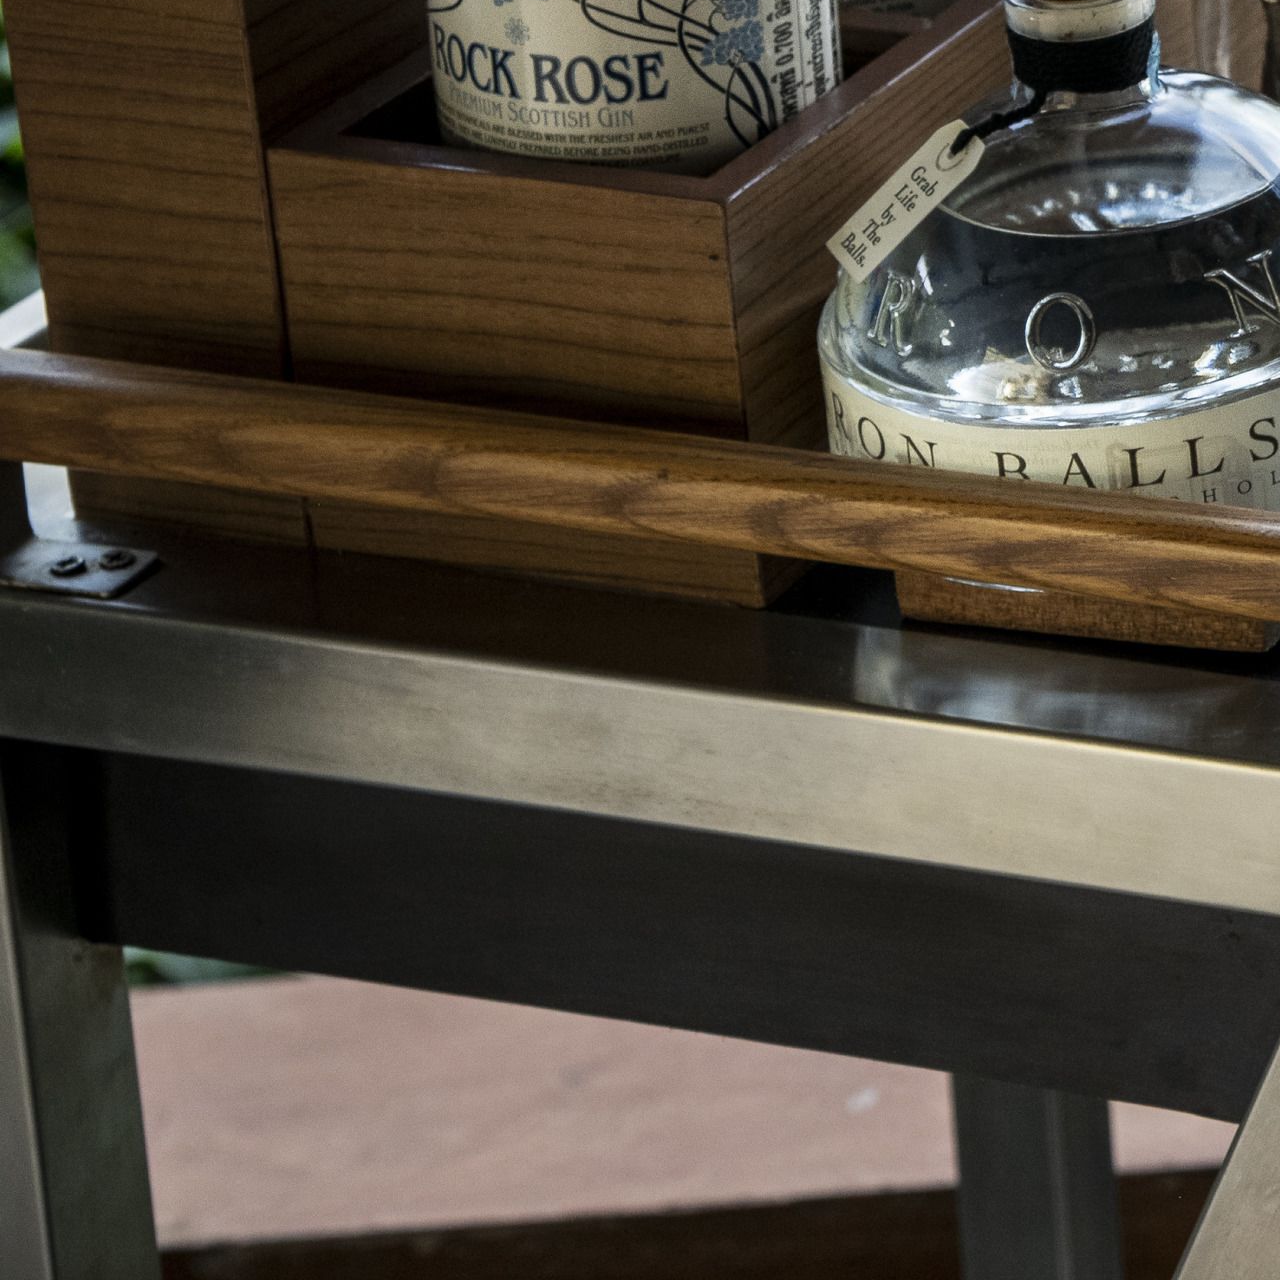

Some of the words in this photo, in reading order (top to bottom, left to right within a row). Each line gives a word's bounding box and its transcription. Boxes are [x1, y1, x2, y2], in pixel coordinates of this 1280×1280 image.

[433, 23, 521, 100] ROCK
[529, 52, 669, 105] ROSE
[508, 103, 590, 129] SCOTTISH
[597, 109, 635, 128] GIN
[910, 165, 940, 198] Grab
[894, 183, 920, 213] Life
[880, 202, 897, 228] by
[861, 217, 882, 247] The
[840, 231, 866, 268] Balls.
